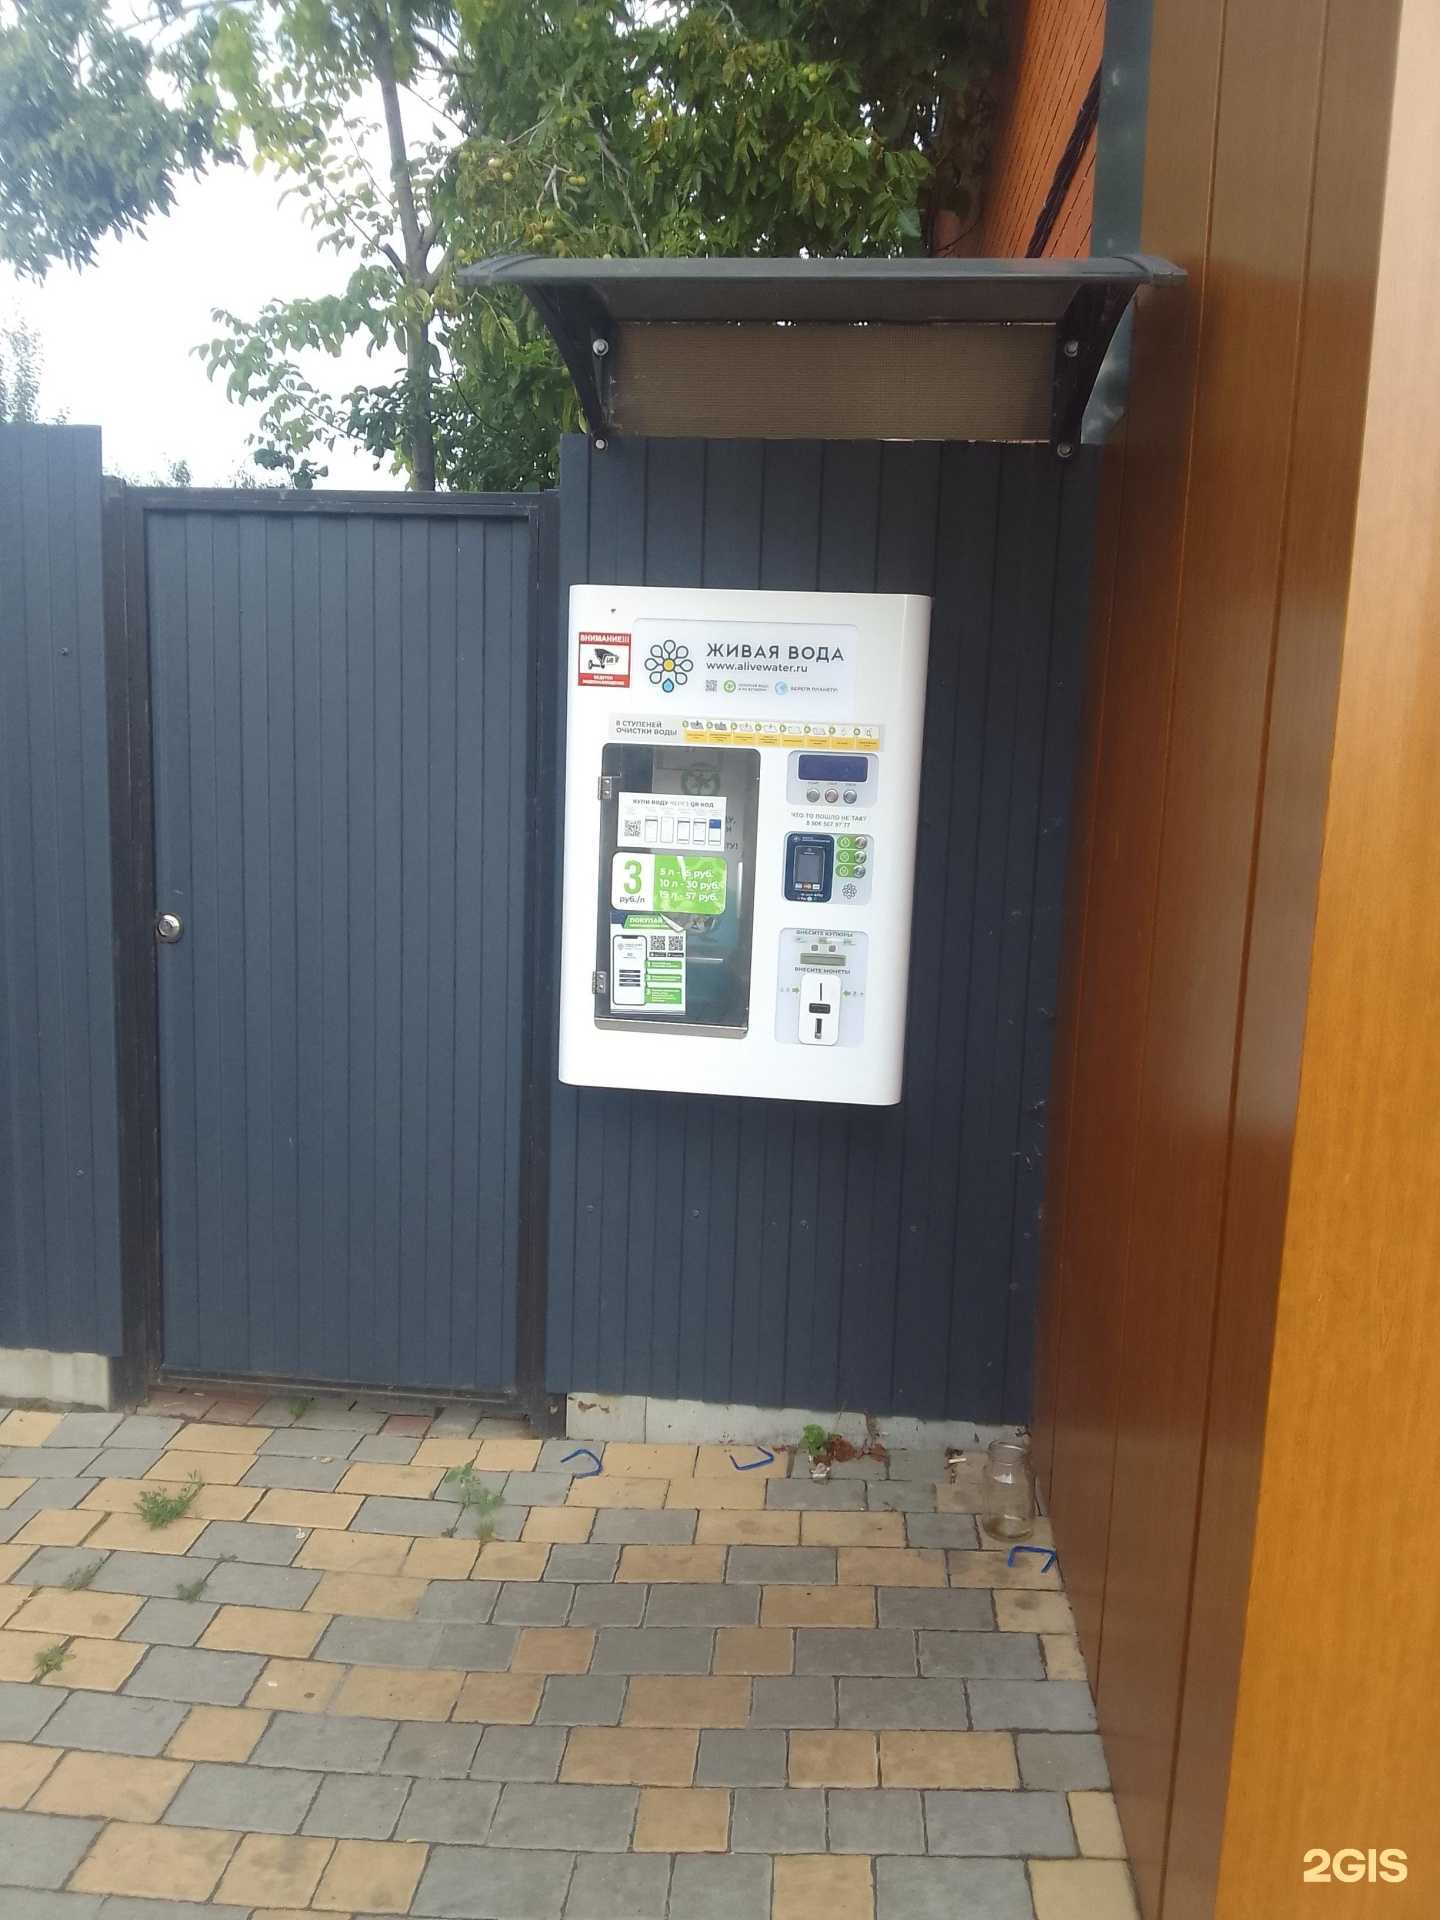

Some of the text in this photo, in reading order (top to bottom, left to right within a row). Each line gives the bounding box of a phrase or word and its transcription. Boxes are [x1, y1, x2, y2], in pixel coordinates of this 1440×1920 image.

[706, 642, 845, 663] ЖИВАЯ ВОДА
[706, 661, 809, 673] www.alivewater.ru
[622, 720, 662, 729] СТУПЕНЕЙ
[616, 727, 652, 736] ОЧИСТКИ
[653, 729, 678, 737] ВОДЫ
[623, 859, 642, 895] 3
[659, 879, 670, 888] 10
